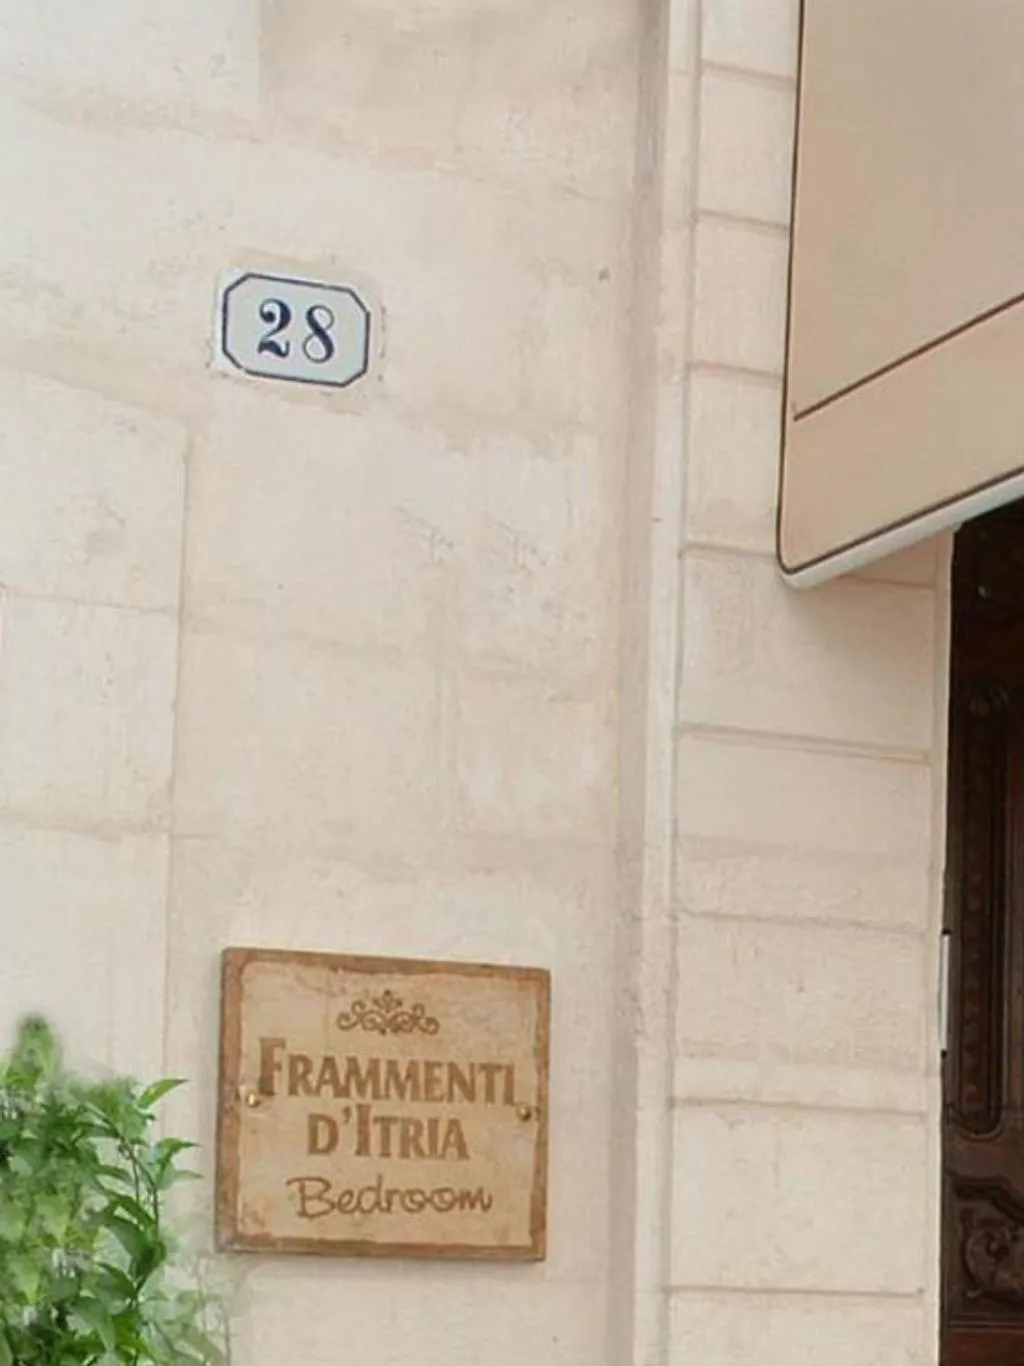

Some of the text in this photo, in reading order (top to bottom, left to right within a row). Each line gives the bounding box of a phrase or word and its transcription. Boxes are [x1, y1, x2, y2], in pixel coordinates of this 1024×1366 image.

[257, 298, 335, 363] 28
[258, 1037, 515, 1106] FRAMMENTI
[306, 1103, 470, 1161] D'ITRIA
[286, 1174, 493, 1219] Bedroom
